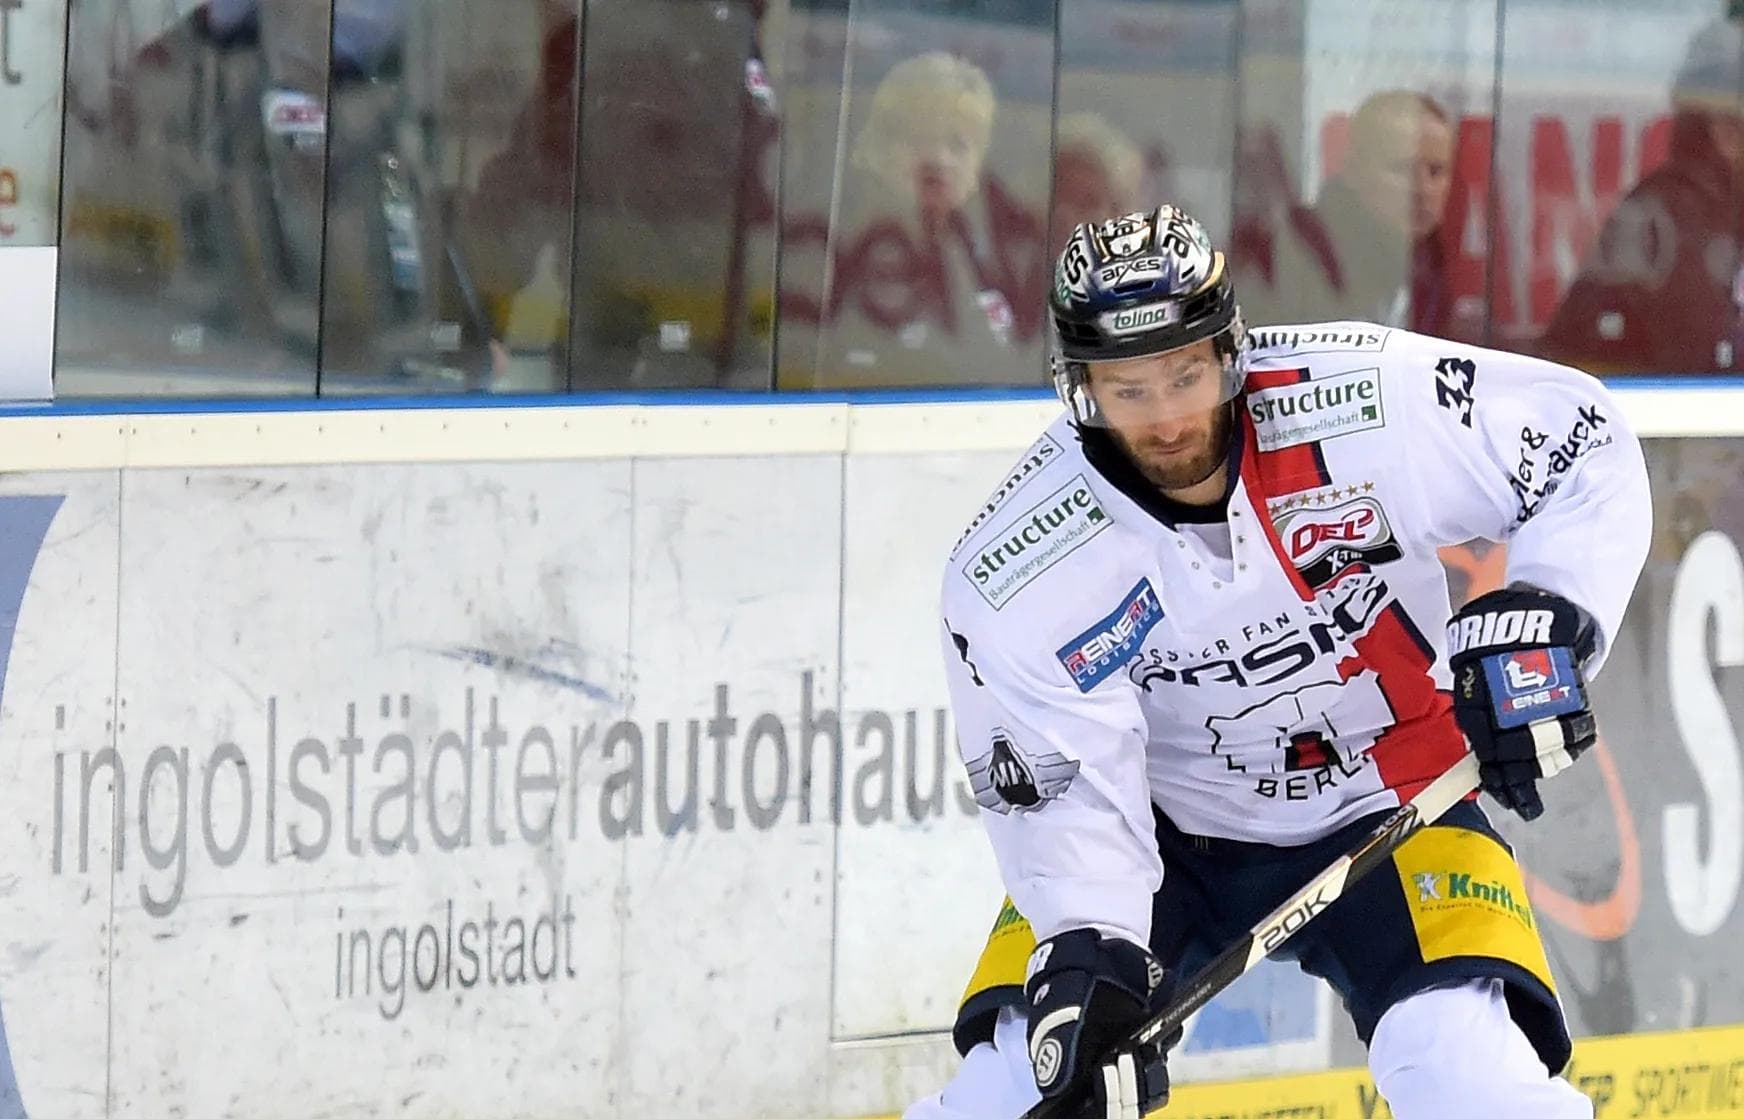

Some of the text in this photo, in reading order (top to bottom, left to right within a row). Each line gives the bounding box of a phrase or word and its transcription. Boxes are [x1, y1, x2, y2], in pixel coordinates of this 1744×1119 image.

[1252, 380, 1375, 425] structure
[1521, 426, 1549, 451] &
[973, 487, 1091, 585] structure
[1292, 508, 1375, 559] DEL
[1243, 611, 1290, 641] FAN
[1260, 885, 1329, 953] 20K
[334, 894, 578, 1020] ingolstadt
